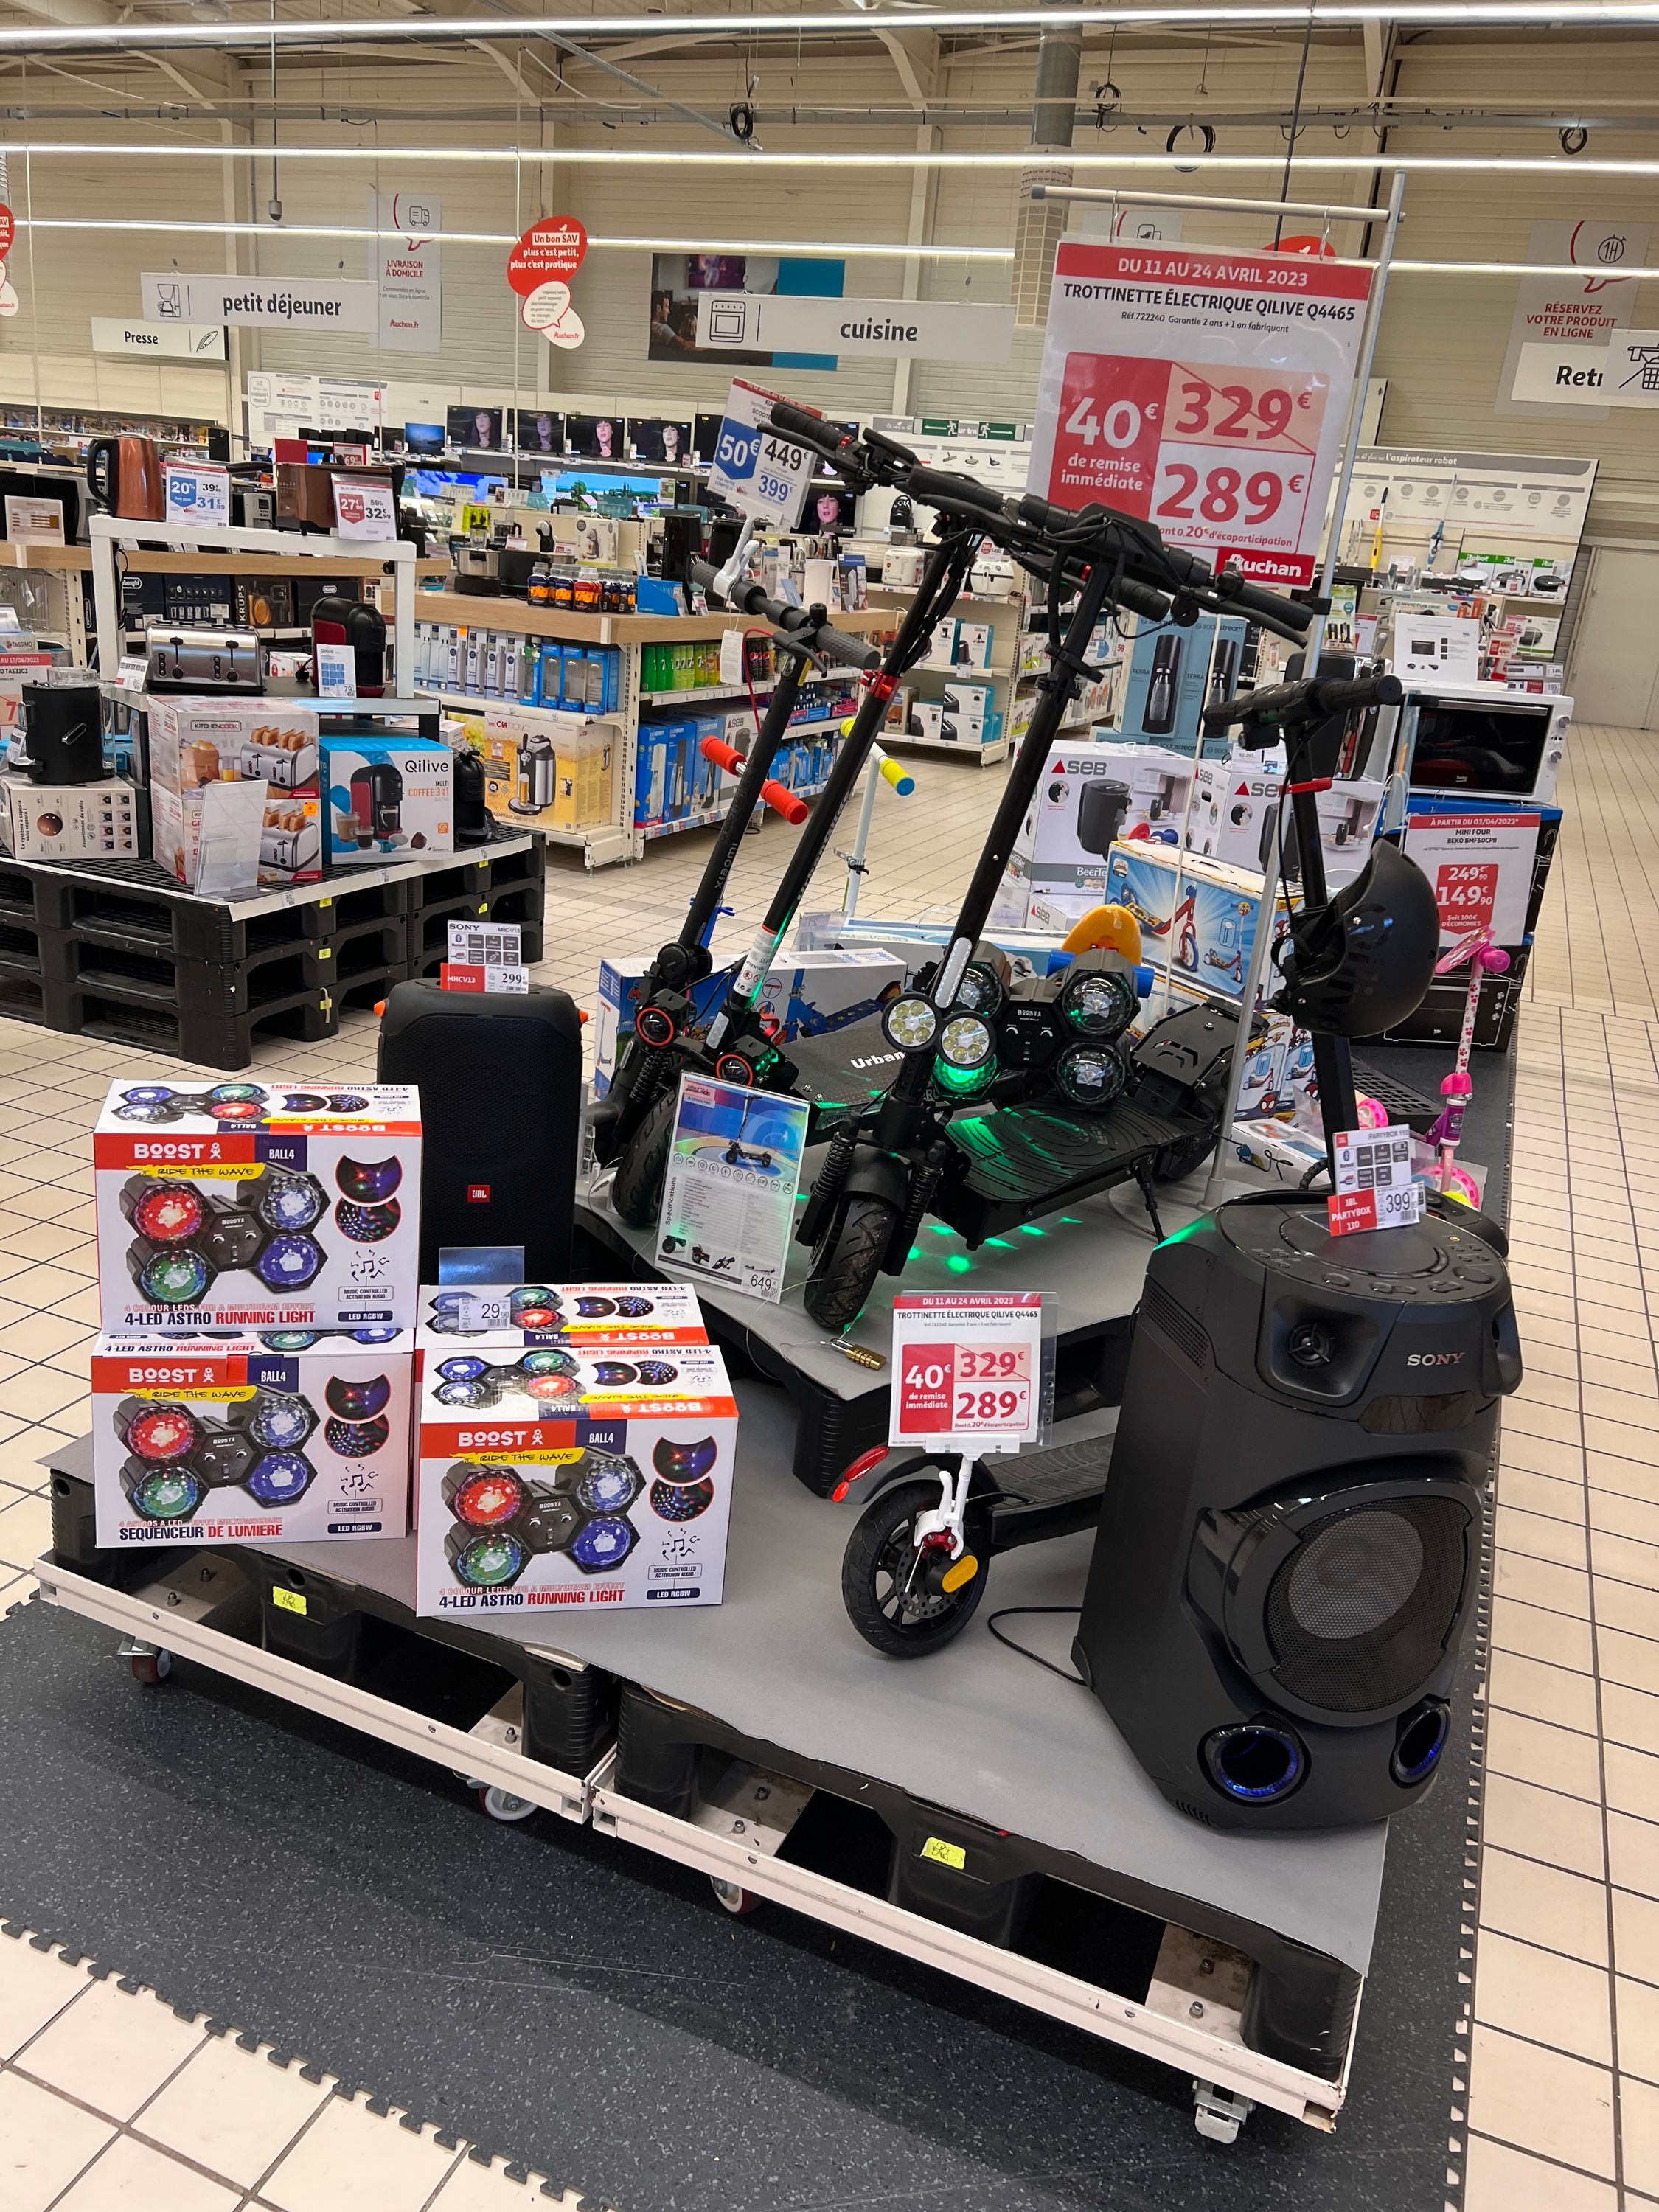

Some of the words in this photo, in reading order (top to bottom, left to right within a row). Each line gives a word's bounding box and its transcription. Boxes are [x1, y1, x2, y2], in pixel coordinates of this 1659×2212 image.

[535, 234, 544, 243] Un
[546, 234, 560, 243] bon
[562, 234, 577, 243] SAV
[524, 248, 539, 257] plus
[540, 248, 557, 257] c'est
[558, 248, 579, 258] petit,
[387, 260, 423, 268] LIVRAISON
[510, 260, 526, 270] plus
[528, 260, 544, 269] c'est
[545, 260, 577, 271] pratique
[386, 268, 391, 276] À
[392, 269, 423, 278] DOMICILE
[1118, 257, 1141, 273] DU
[1144, 260, 1161, 274] 11
[1169, 261, 1189, 276] AU
[1192, 263, 1212, 279] 24
[1214, 265, 1263, 283] AVRIL
[1266, 269, 1309, 287] 2023
[1063, 283, 1162, 305] TROTTINETTE
[1164, 288, 1253, 313] ÉLECTRIQUE
[1256, 299, 1304, 317] QILIVE
[1307, 303, 1355, 321] Q4465
[1545, 301, 1603, 315] RÉSERVEZ
[223, 293, 262, 326] petit
[267, 293, 342, 326] déjeuner
[390, 319, 419, 328] Auchan.fr
[1121, 311, 1165, 323] Réf.722240
[1168, 315, 1201, 326] Garantie
[1209, 319, 1223, 327] ans
[1248, 321, 1289, 333] fabriquant
[1526, 314, 1565, 325] VOTRE
[1566, 316, 1618, 327] PRODUIT
[840, 317, 918, 341] cuisine
[1543, 327, 1558, 337] EN
[1560, 327, 1594, 338] LIGNE
[125, 332, 159, 345] Presse
[1068, 453, 1087, 468] de
[1090, 456, 1141, 473] remise
[1386, 454, 1433, 465] l'aspirateur
[1434, 456, 1458, 465] robot
[1060, 470, 1144, 491] immédiate
[1159, 526, 1175, 536] ont
[1209, 530, 1293, 547] d'écoparticipation
[1226, 553, 1302, 578] Auchan
[405, 759, 449, 773] Qilive
[408, 788, 434, 797] COFFEE
[1077, 866, 1107, 877] BeerTe
[1368, 1131, 1397, 1140] PARTYBOX
[134, 1143, 205, 1160] BOOST
[269, 1148, 295, 1160] BALL4
[157, 1167, 188, 1176] RIDE
[191, 1166, 215, 1176] THE
[218, 1166, 254, 1177] WAVE
[472, 1189, 487, 1199] JBL
[665, 1176, 677, 1226] Spécifications
[1345, 1198, 1357, 1207] JBL
[1332, 1206, 1371, 1221] PARTYBOX
[1346, 1220, 1360, 1230] 110
[125, 1313, 163, 1326] 4-LED
[167, 1312, 212, 1325] ASTRO
[215, 1311, 276, 1324] RUNNING
[279, 1310, 316, 1324] LIGHT
[348, 1312, 361, 1321] LED
[364, 1312, 383, 1321] RGBW
[947, 1310, 990, 1319] ÉLECTRIQUE
[1407, 1352, 1466, 1366] SONY
[129, 1368, 198, 1383] BOOST
[260, 1371, 286, 1382] BALL4
[151, 1391, 181, 1399] RIDE
[210, 1390, 246, 1399] WAVE
[909, 1392, 919, 1400] de
[905, 1400, 948, 1410] immédiate
[459, 1430, 527, 1447] BOOST
[589, 1433, 614, 1444] BALL4
[119, 1526, 204, 1540] SEQUENCEUR
[207, 1526, 224, 1538] DE
[227, 1524, 282, 1537] LUMIERE
[439, 1593, 476, 1608] 4-LED
[480, 1593, 524, 1607] ASTRO
[527, 1591, 586, 1605] RUNNING
[589, 1590, 625, 1603] LIGHT
